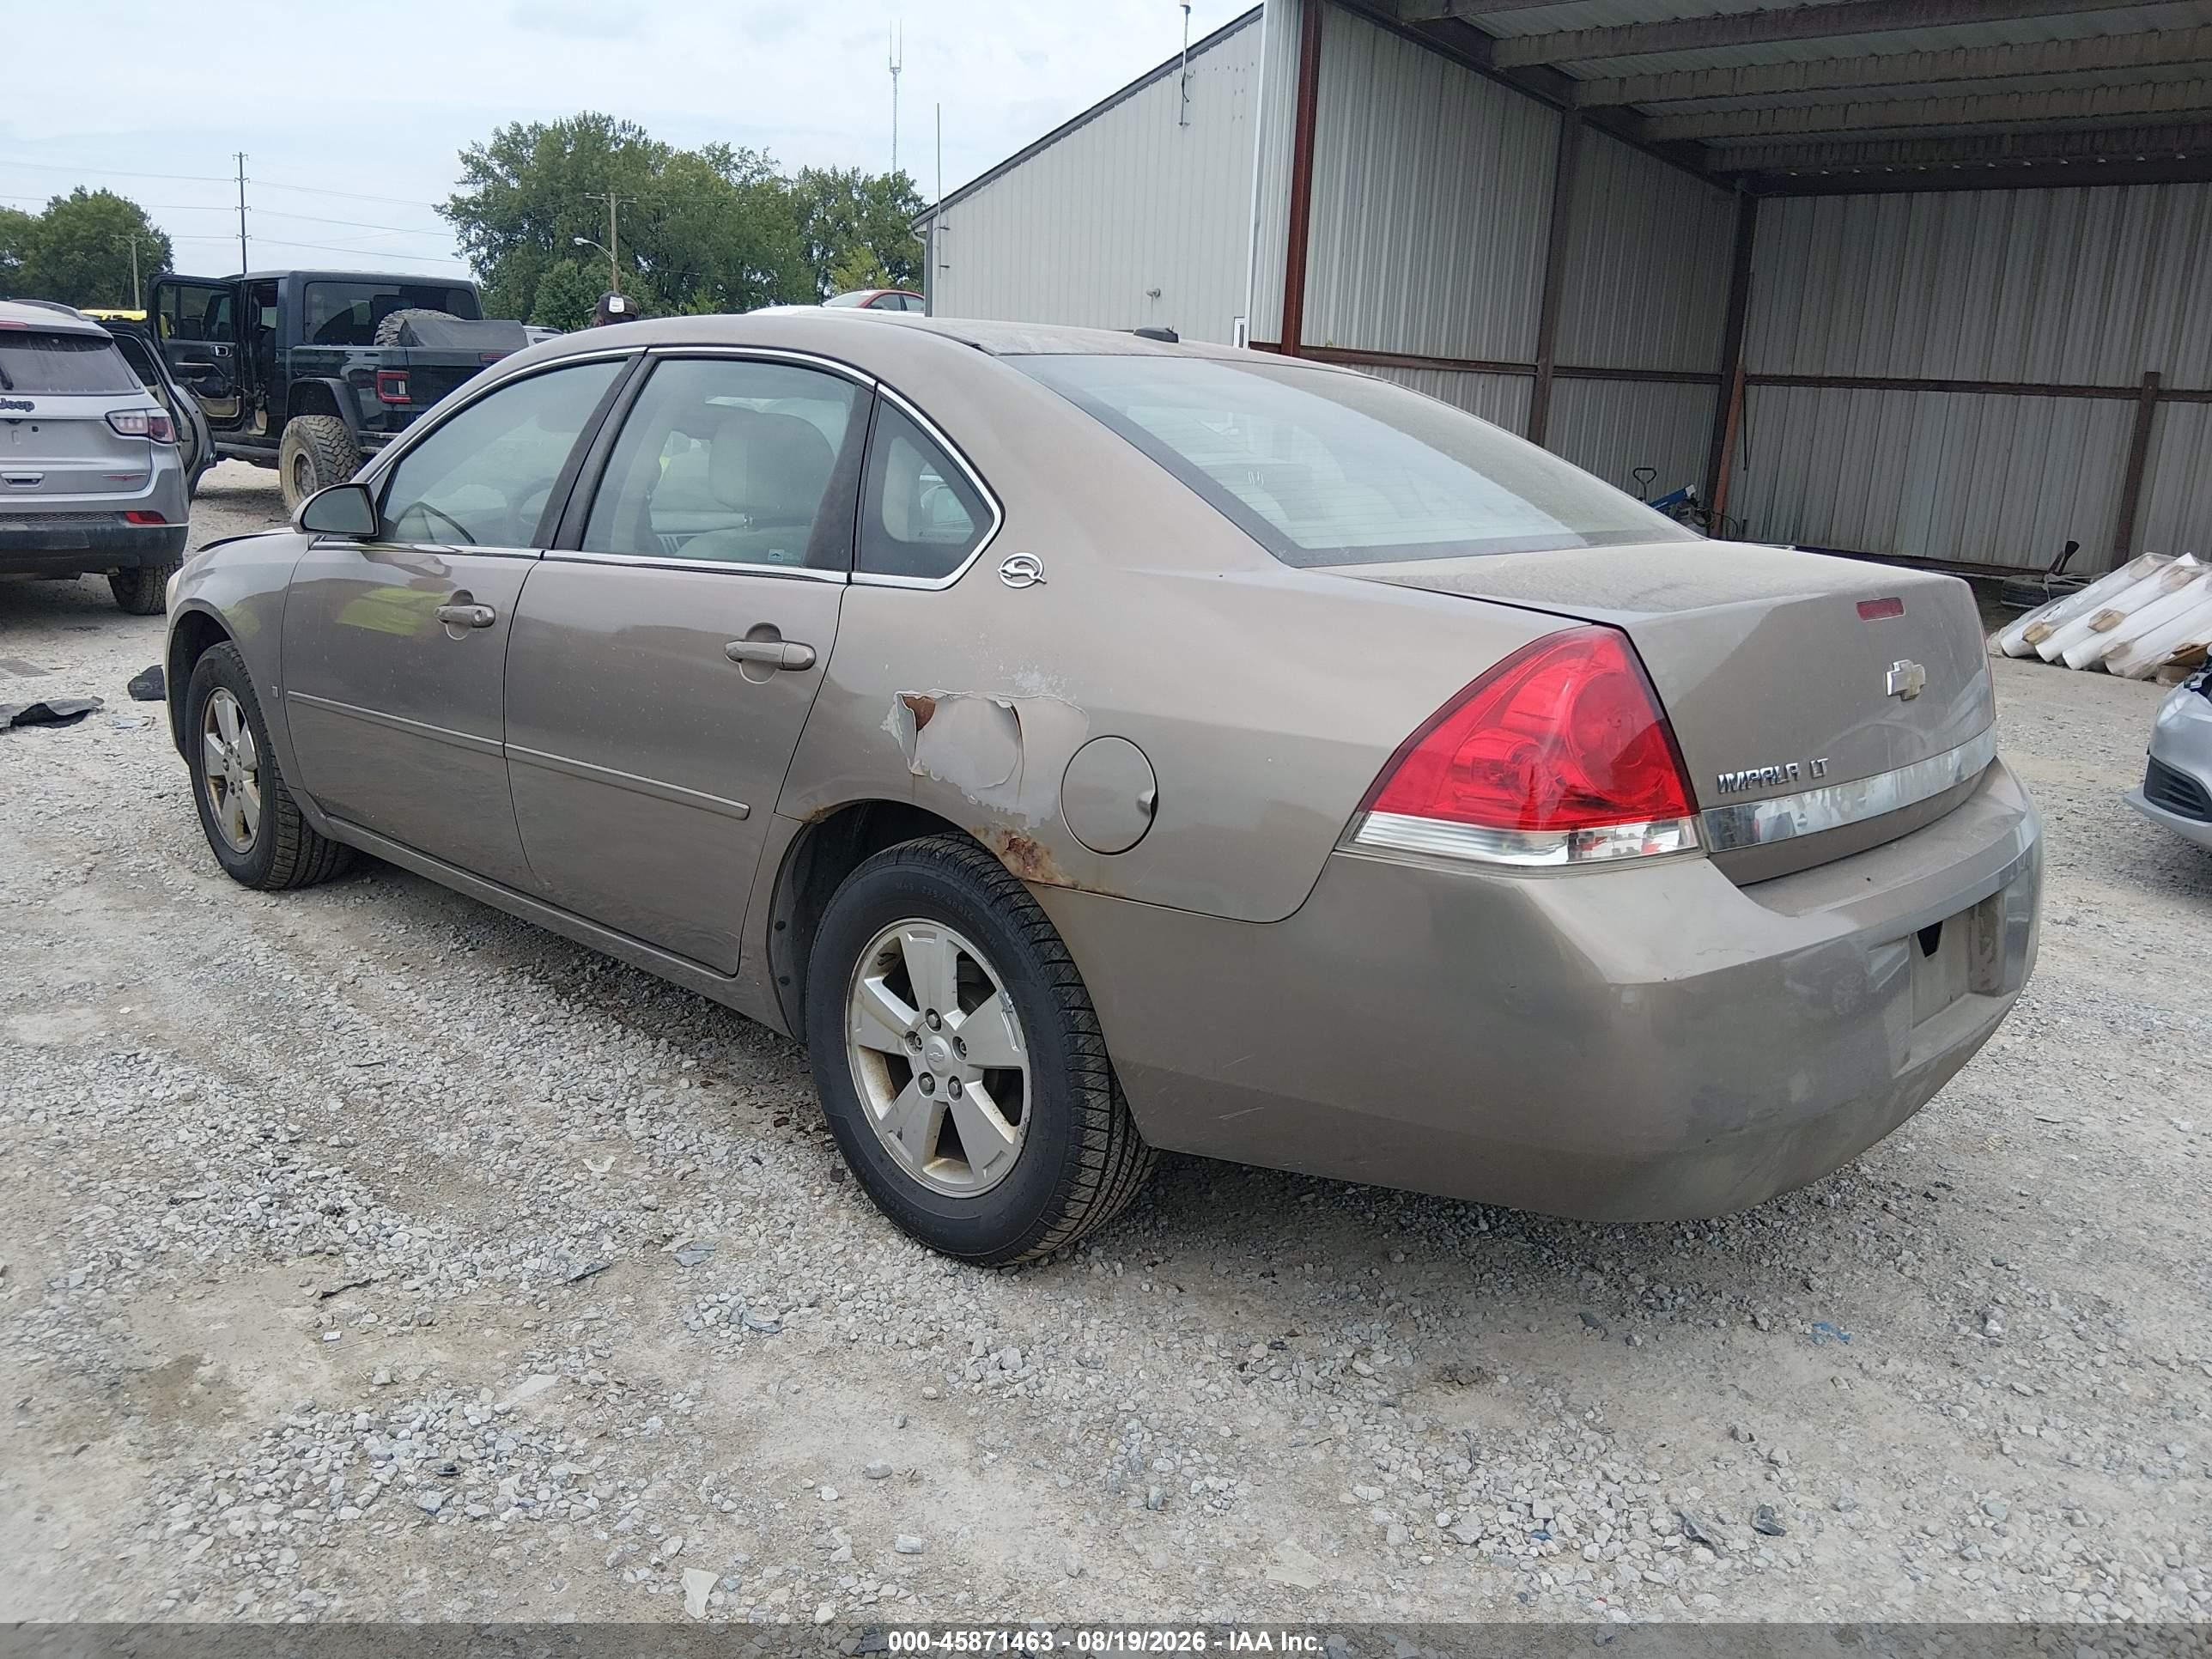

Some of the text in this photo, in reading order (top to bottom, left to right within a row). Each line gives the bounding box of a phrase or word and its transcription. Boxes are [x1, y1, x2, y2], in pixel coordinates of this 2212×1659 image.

[0, 398, 35, 412] Jeep
[1717, 757, 1829, 794] IMPALA LT
